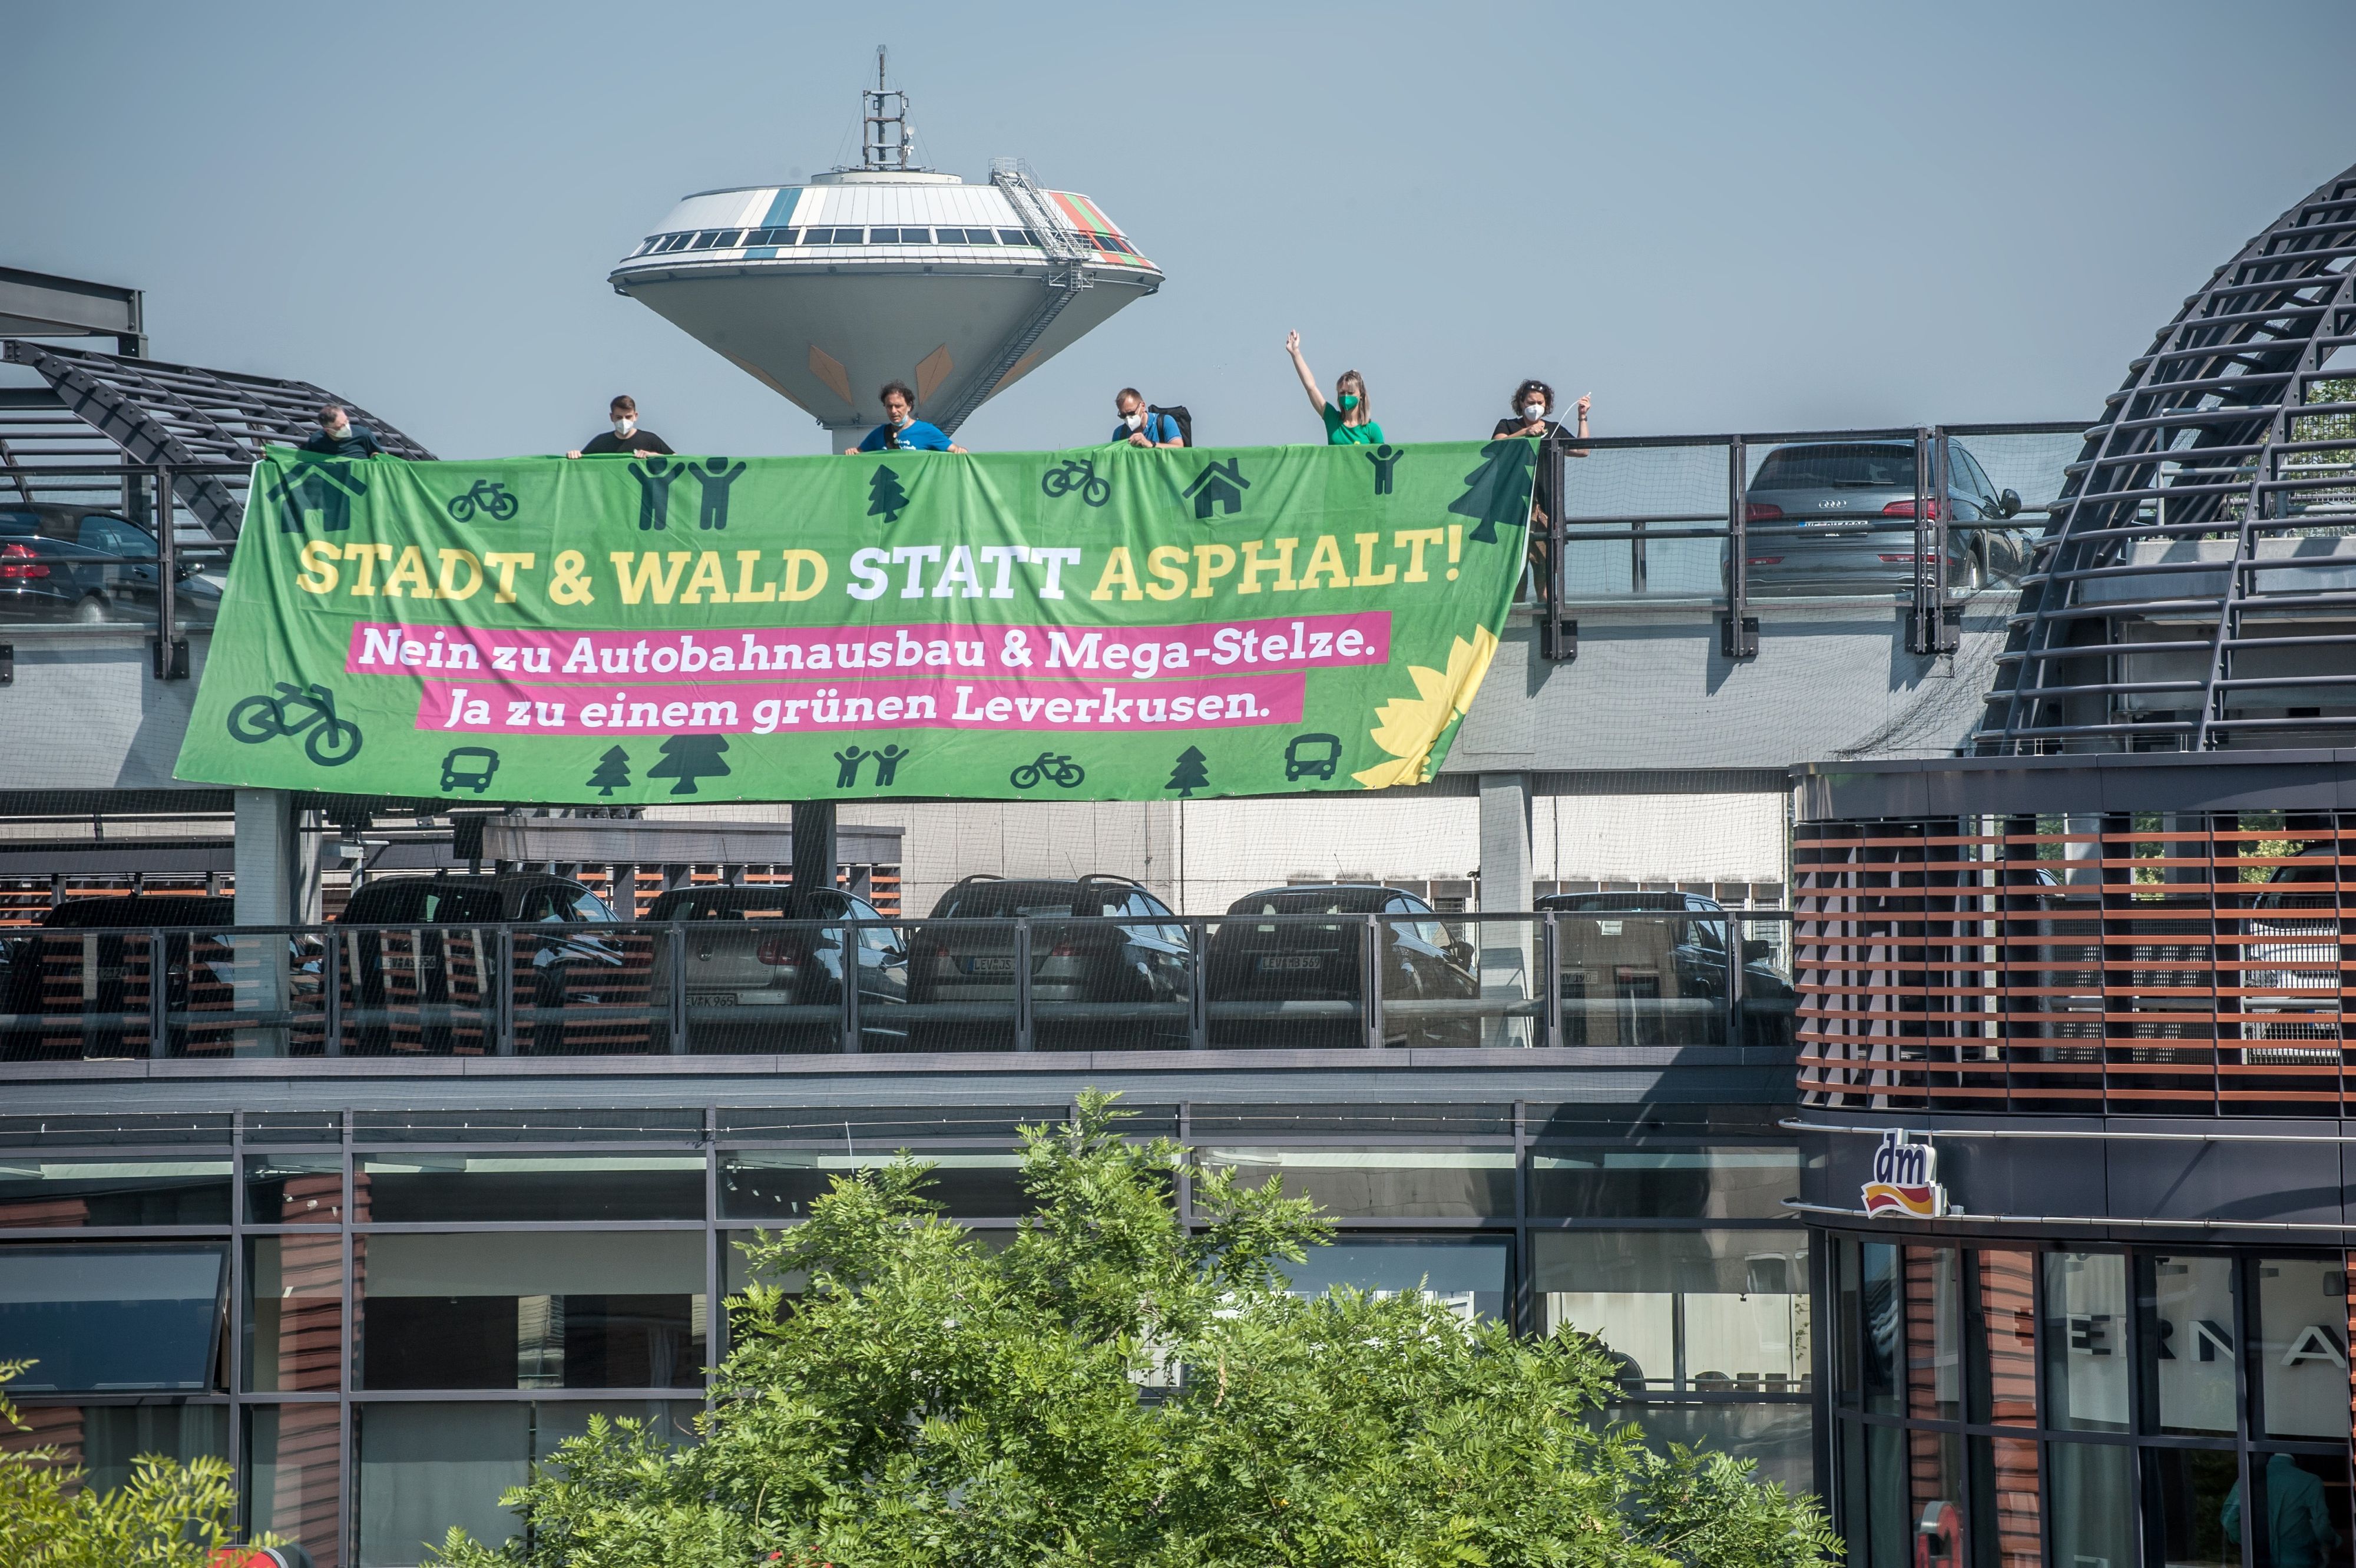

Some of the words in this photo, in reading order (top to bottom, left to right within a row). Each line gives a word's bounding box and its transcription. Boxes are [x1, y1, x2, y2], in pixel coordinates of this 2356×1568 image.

[297, 541, 535, 604] STADT
[549, 550, 595, 606] &
[610, 549, 828, 604] WALD
[846, 544, 1081, 601] STATT
[1091, 525, 1462, 601] ASPHALT!
[358, 627, 479, 671] Nein
[491, 646, 551, 674] zu
[561, 633, 985, 674] Autobahnausbau
[1000, 628, 1034, 669] &
[1044, 621, 1376, 680] Mega-Stelze.
[444, 688, 491, 728] Ja
[505, 700, 565, 727] zu
[579, 692, 739, 728] einem
[751, 688, 937, 735] grünen
[951, 685, 1270, 723] Leverkusen.
[1876, 1132, 1927, 1185] dm
